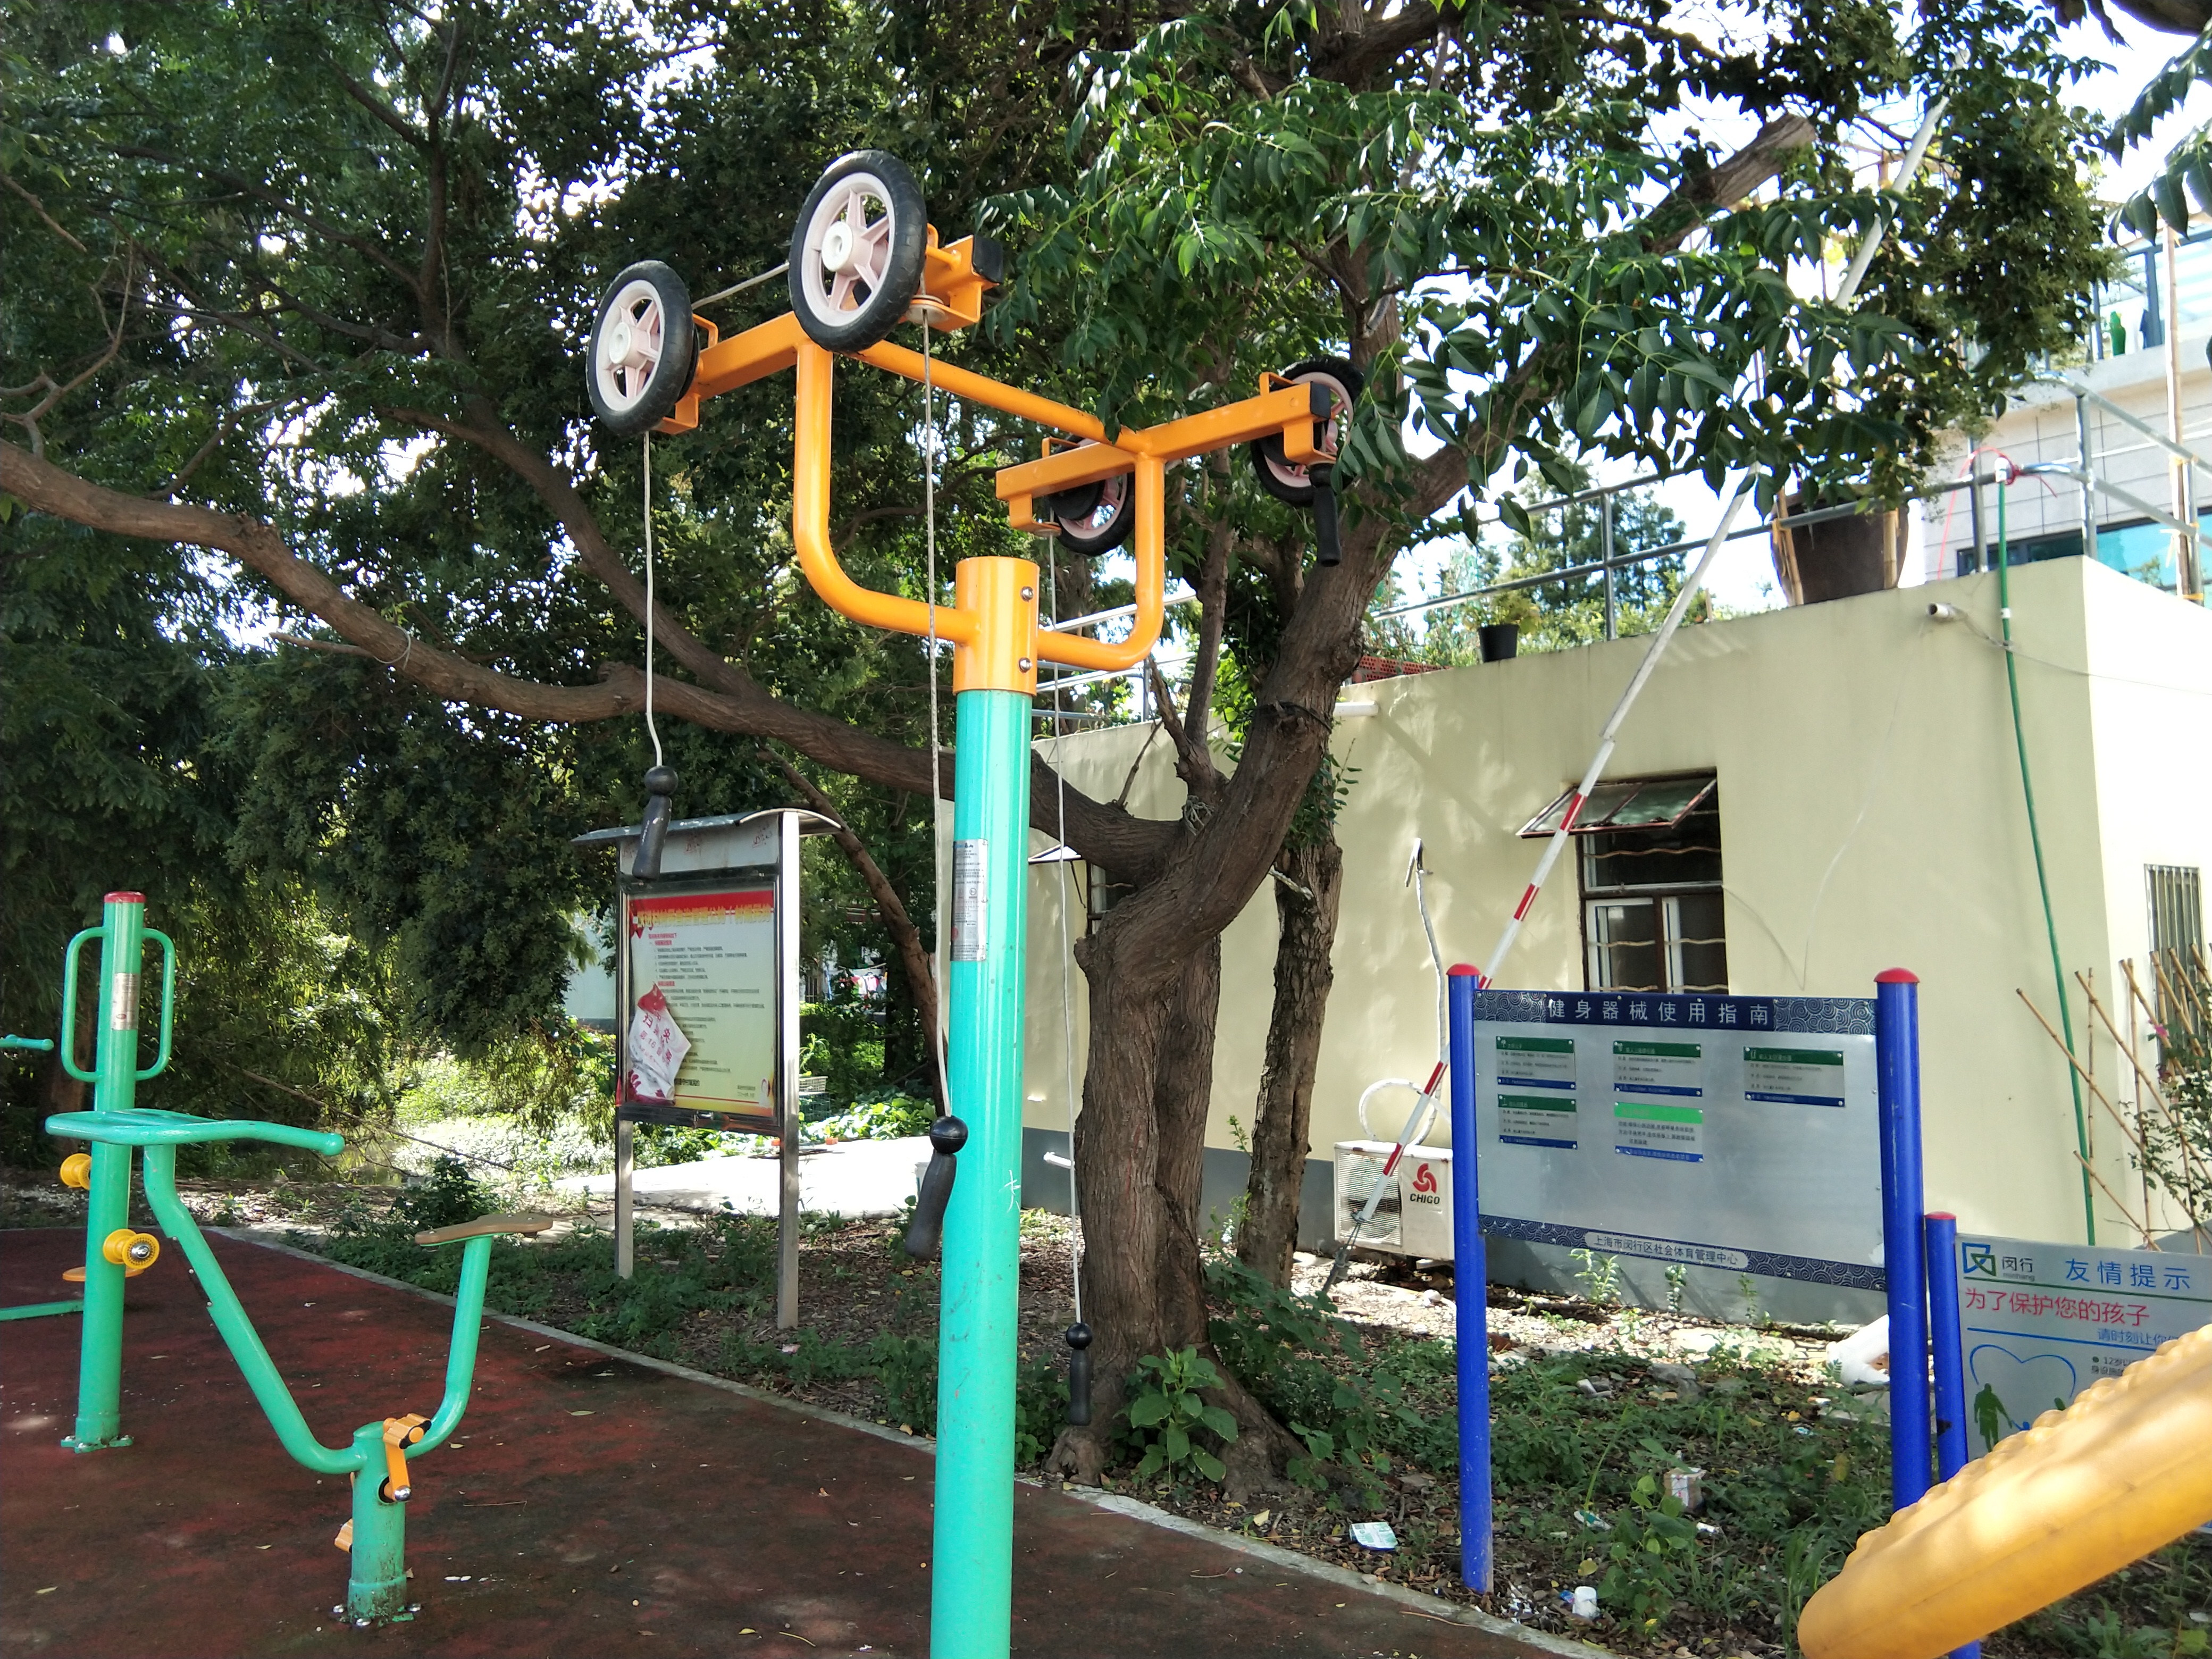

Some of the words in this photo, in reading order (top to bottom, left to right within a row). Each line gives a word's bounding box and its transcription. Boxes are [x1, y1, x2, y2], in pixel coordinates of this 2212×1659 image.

[1548, 999, 1769, 1026] 健身器械使用指南
[1410, 1193, 1440, 1205] CHIGO
[1594, 1234, 1738, 1265] 上海市闵行区社会体育管理中心
[2002, 1256, 2033, 1272] 闵行
[2065, 1258, 2190, 1290] 友情提示
[1965, 1287, 2150, 1327] 为了保护您的孩子
[2097, 1328, 2179, 1346] 请时刻让你
